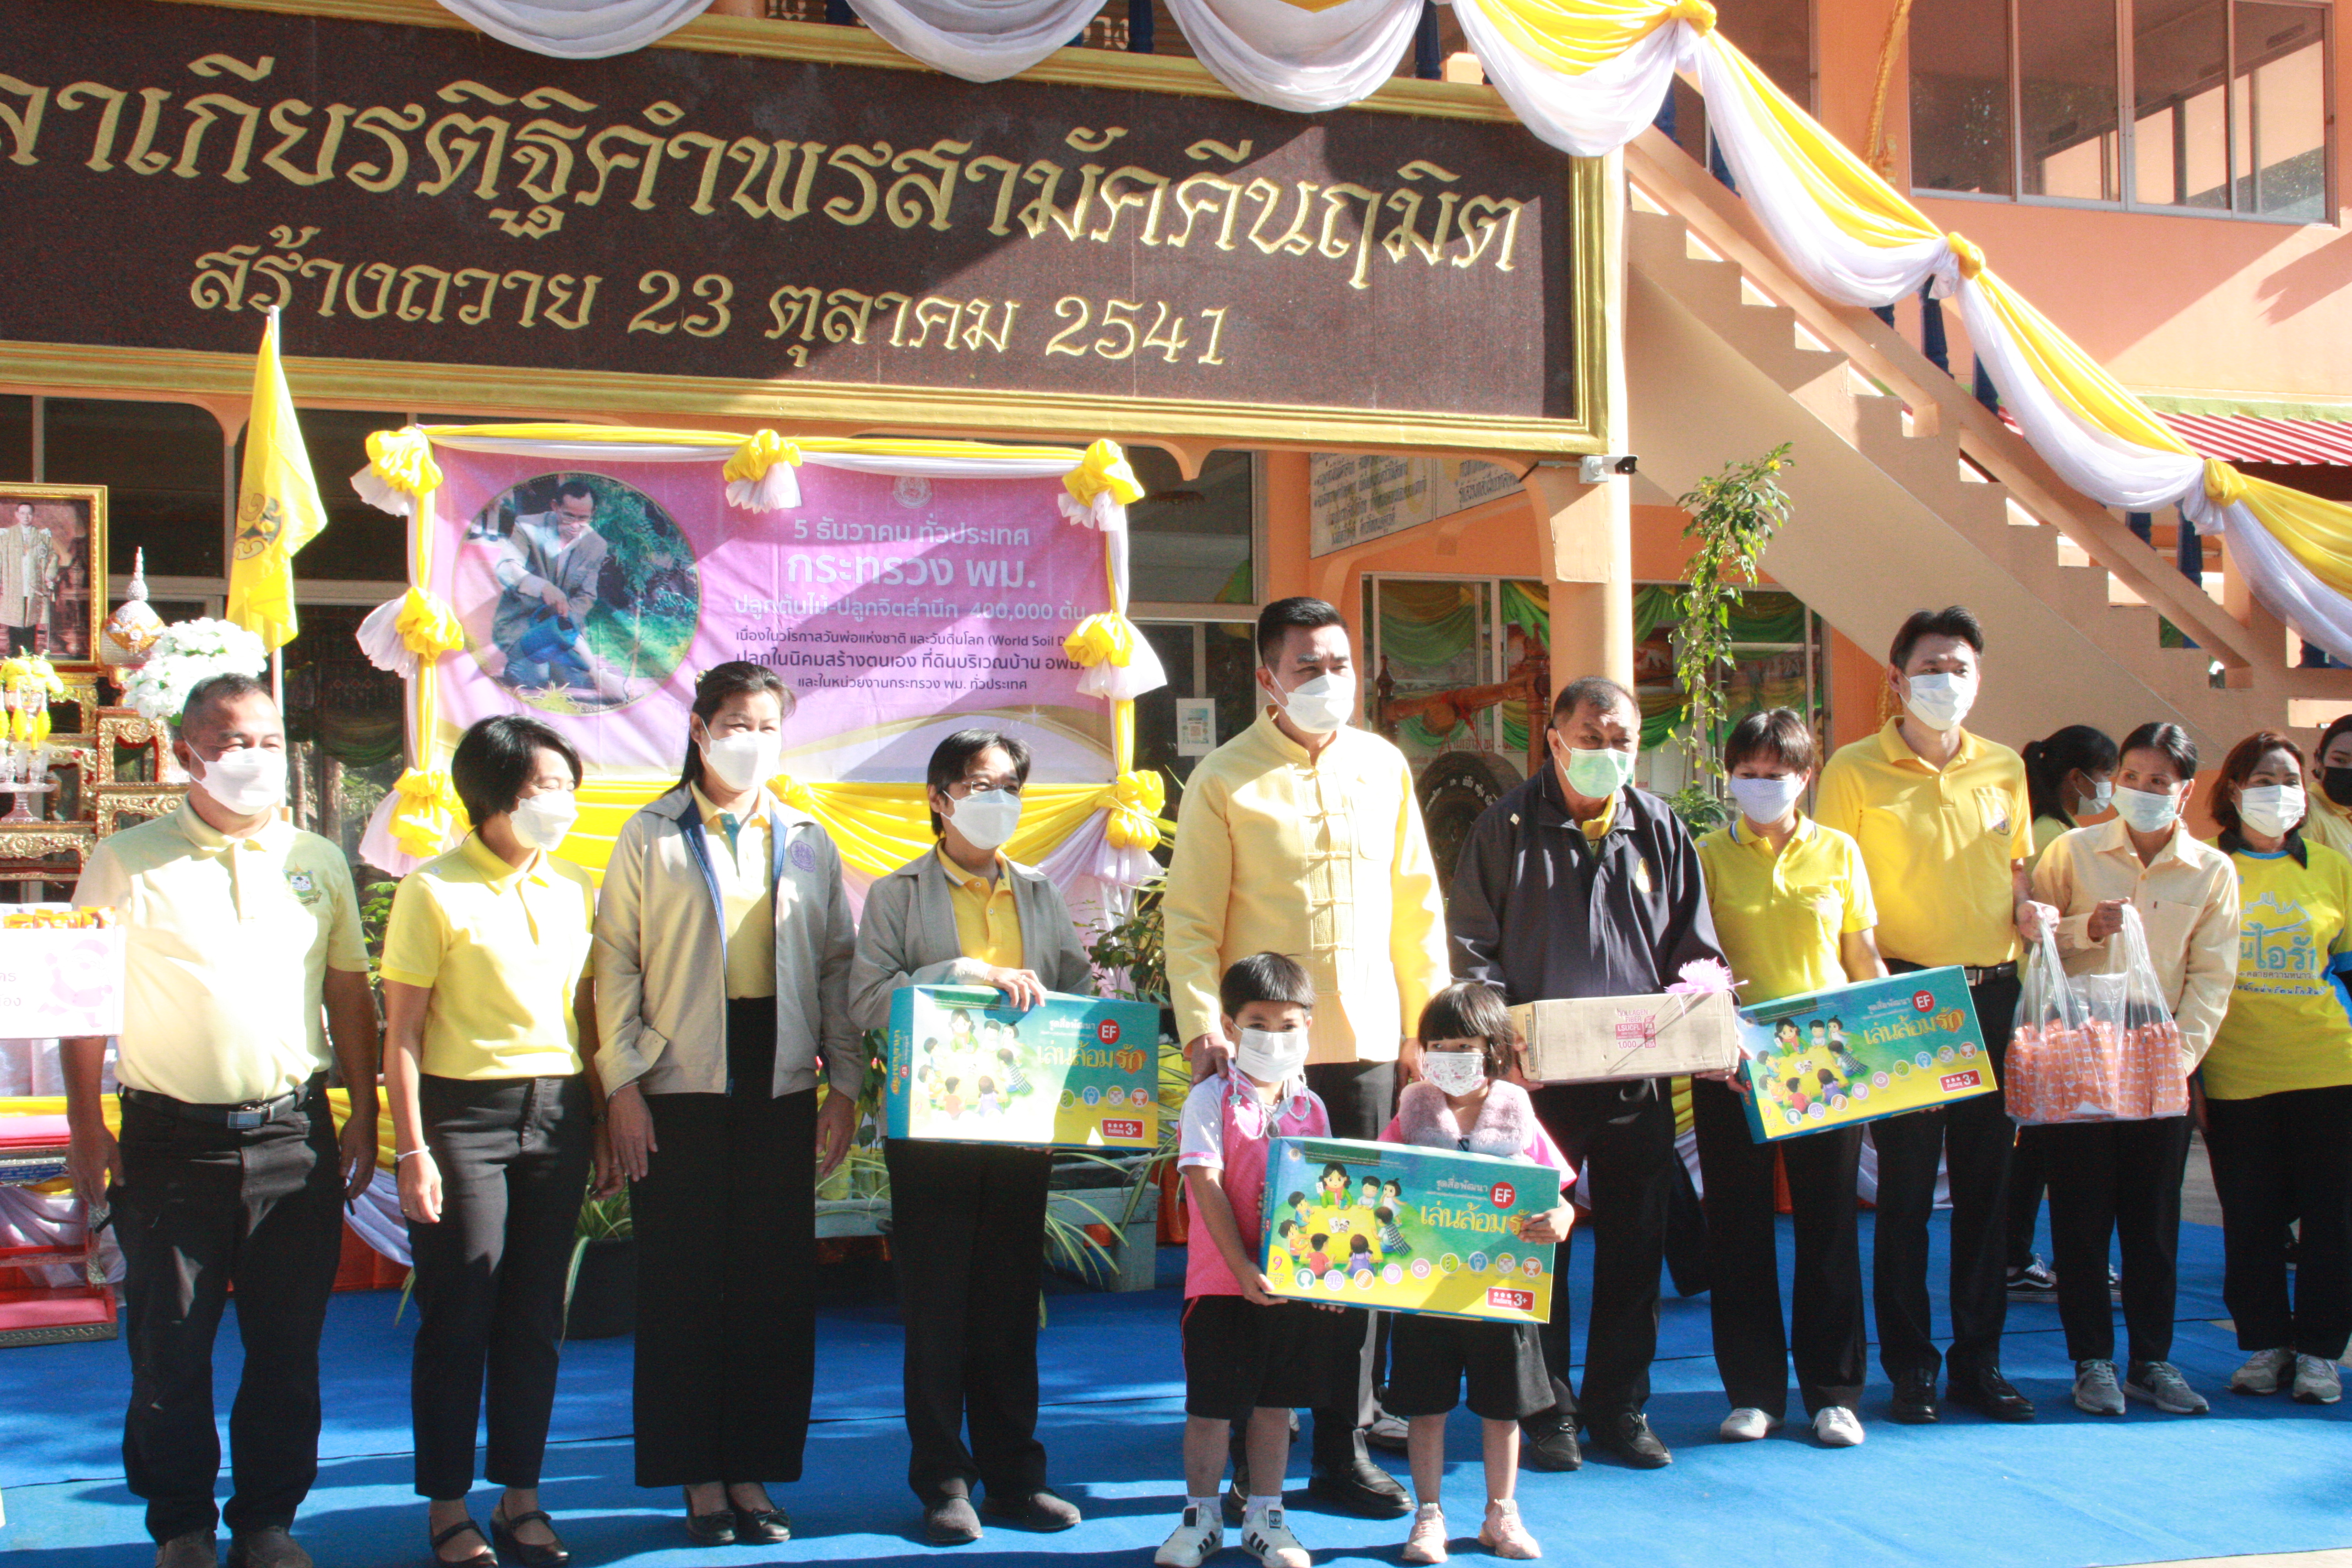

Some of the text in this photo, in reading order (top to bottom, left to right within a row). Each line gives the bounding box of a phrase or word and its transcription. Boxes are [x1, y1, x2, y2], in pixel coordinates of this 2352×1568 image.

[191, 225, 1229, 368] สร้างถวาย 23 ตุลาคม 2541
[794, 513, 1030, 546] 5 ธันวาคม ทั่วประเทศ
[787, 553, 1036, 589] กระทรวง พม.
[970, 602, 1053, 622] 400,000
[1059, 600, 1086, 620] ต้น
[910, 631, 984, 645] และวันดินโลก
[988, 635, 1028, 647] (World
[1032, 635, 1054, 646] Soil
[922, 648, 1040, 670] ที่ดินบริเวณบ้าน
[798, 673, 1027, 690] และในหน่วยงานกระทรวง พม. ทั่วประเทศ
[1916, 994, 1931, 1009] EF
[1102, 1024, 1117, 1039] EF
[1863, 1007, 1963, 1045] เล่นล้อมรัก
[1618, 1041, 1637, 1049] 1,000
[1037, 1039, 1144, 1071] เล่นล้อมรัก
[1962, 1074, 1975, 1086] 3+
[1763, 1106, 1772, 1118] 9
[1125, 1123, 1138, 1135] 3+
[1494, 1188, 1512, 1202] EF
[1420, 1200, 1531, 1236] เล่นล้อมรั
[1273, 1256, 1283, 1270] 9
[1274, 1277, 1284, 1285] EF
[1513, 1293, 1528, 1306] 3+
